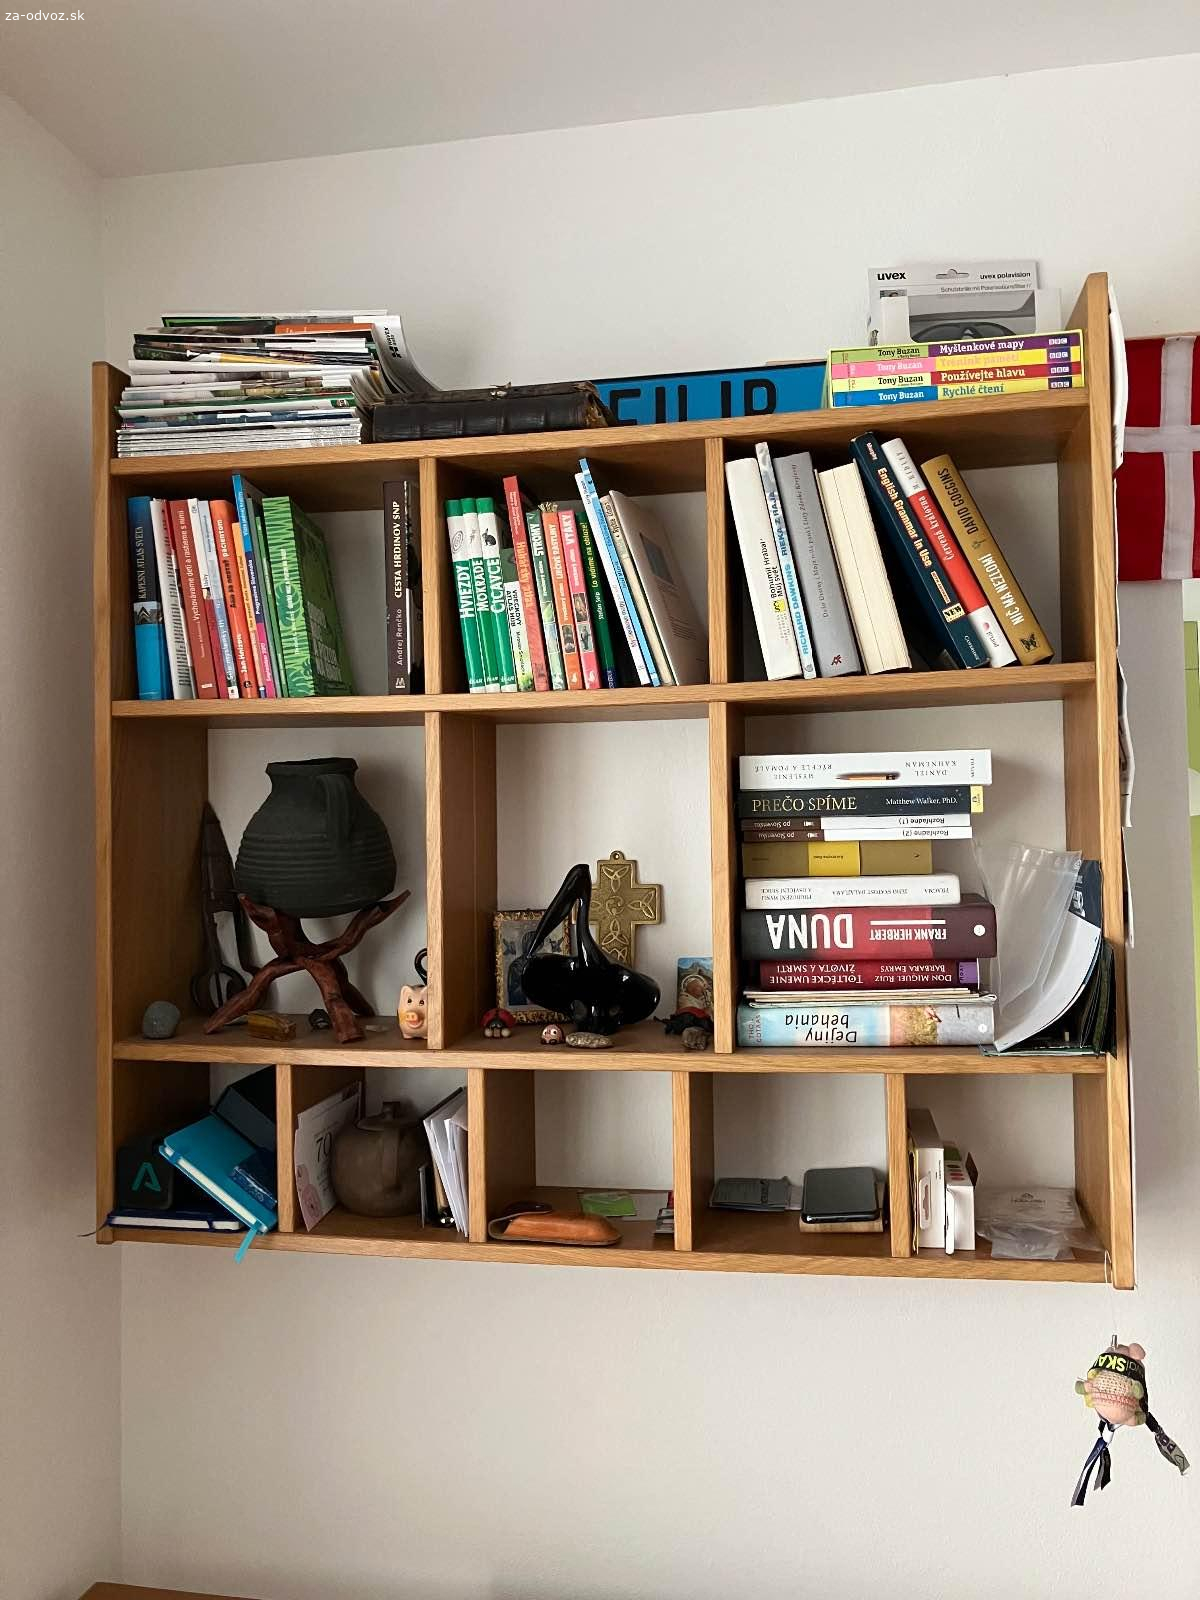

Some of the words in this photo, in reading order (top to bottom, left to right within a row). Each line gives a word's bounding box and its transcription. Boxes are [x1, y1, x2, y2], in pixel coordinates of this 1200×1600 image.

[877, 271, 907, 281] uvex
[878, 349, 895, 358] Tony
[896, 346, 921, 356] Buzan
[939, 340, 996, 355] Myšlenkové
[997, 339, 1025, 351] mapy
[1049, 337, 1068, 345] BBC
[877, 363, 896, 372] Tony
[897, 360, 923, 370] Buzan
[1049, 351, 1069, 360] BBC
[878, 376, 897, 386] Tony
[897, 374, 924, 384] Buzan
[940, 369, 994, 384] Používejte
[995, 367, 1025, 379] hlavu
[1050, 365, 1069, 374] BBC
[878, 391, 897, 402] Tony
[898, 389, 924, 400] Buzan
[942, 385, 977, 398] Rychlé
[978, 383, 1004, 395] čtení
[1050, 379, 1070, 388] BBC
[938, 468, 964, 507] GOGGINS
[769, 491, 779, 516] RAJA
[919, 496, 939, 529] královna
[878, 468, 898, 499] English
[895, 500, 918, 538] Grammar
[914, 538, 924, 550] in
[920, 549, 932, 566] Use
[958, 507, 979, 534] DAVID
[218, 520, 229, 557] pacientom
[394, 523, 402, 567] HRDINOV
[531, 524, 544, 556] STROMY
[777, 527, 788, 556] RIEKA
[934, 530, 954, 560] Červená
[587, 547, 593, 555] na
[761, 541, 770, 565] Hrabal
[766, 567, 777, 598] Bohumil
[979, 554, 1007, 592] NEZLOMÍ
[457, 566, 474, 618] HVIEZDY
[473, 561, 489, 611] MOKRADE
[488, 560, 505, 613] CICAVCE
[785, 564, 799, 609] DAWKINS
[1001, 592, 1016, 608] MA
[945, 605, 963, 618] NEW
[1006, 607, 1024, 625] NIČ
[795, 612, 809, 654] RICHARD
[904, 760, 957, 769] KAHNEMAN
[914, 769, 947, 777] DANIEL
[752, 795, 804, 812] PREČO
[808, 794, 857, 811] SPÍME
[898, 817, 909, 826] (1)
[901, 829, 913, 837] (2)
[765, 913, 854, 950] DUNA
[869, 928, 913, 942] HERBERT
[914, 928, 947, 941] FRANK
[776, 964, 808, 974] SMRTI
[809, 964, 816, 973] A
[817, 963, 856, 974] ŽIVOTA
[880, 965, 907, 973] EMRYS
[909, 965, 945, 973] BARBARA
[769, 975, 809, 984] UMENIE
[811, 974, 864, 985] TOLTÉCKE
[874, 975, 895, 983] RUIZ
[896, 974, 929, 984] MIGUEL
[931, 974, 952, 983] DON
[785, 1013, 849, 1028] behania
[805, 1028, 857, 1044] Dejiny
[315, 1131, 332, 1163] 70
